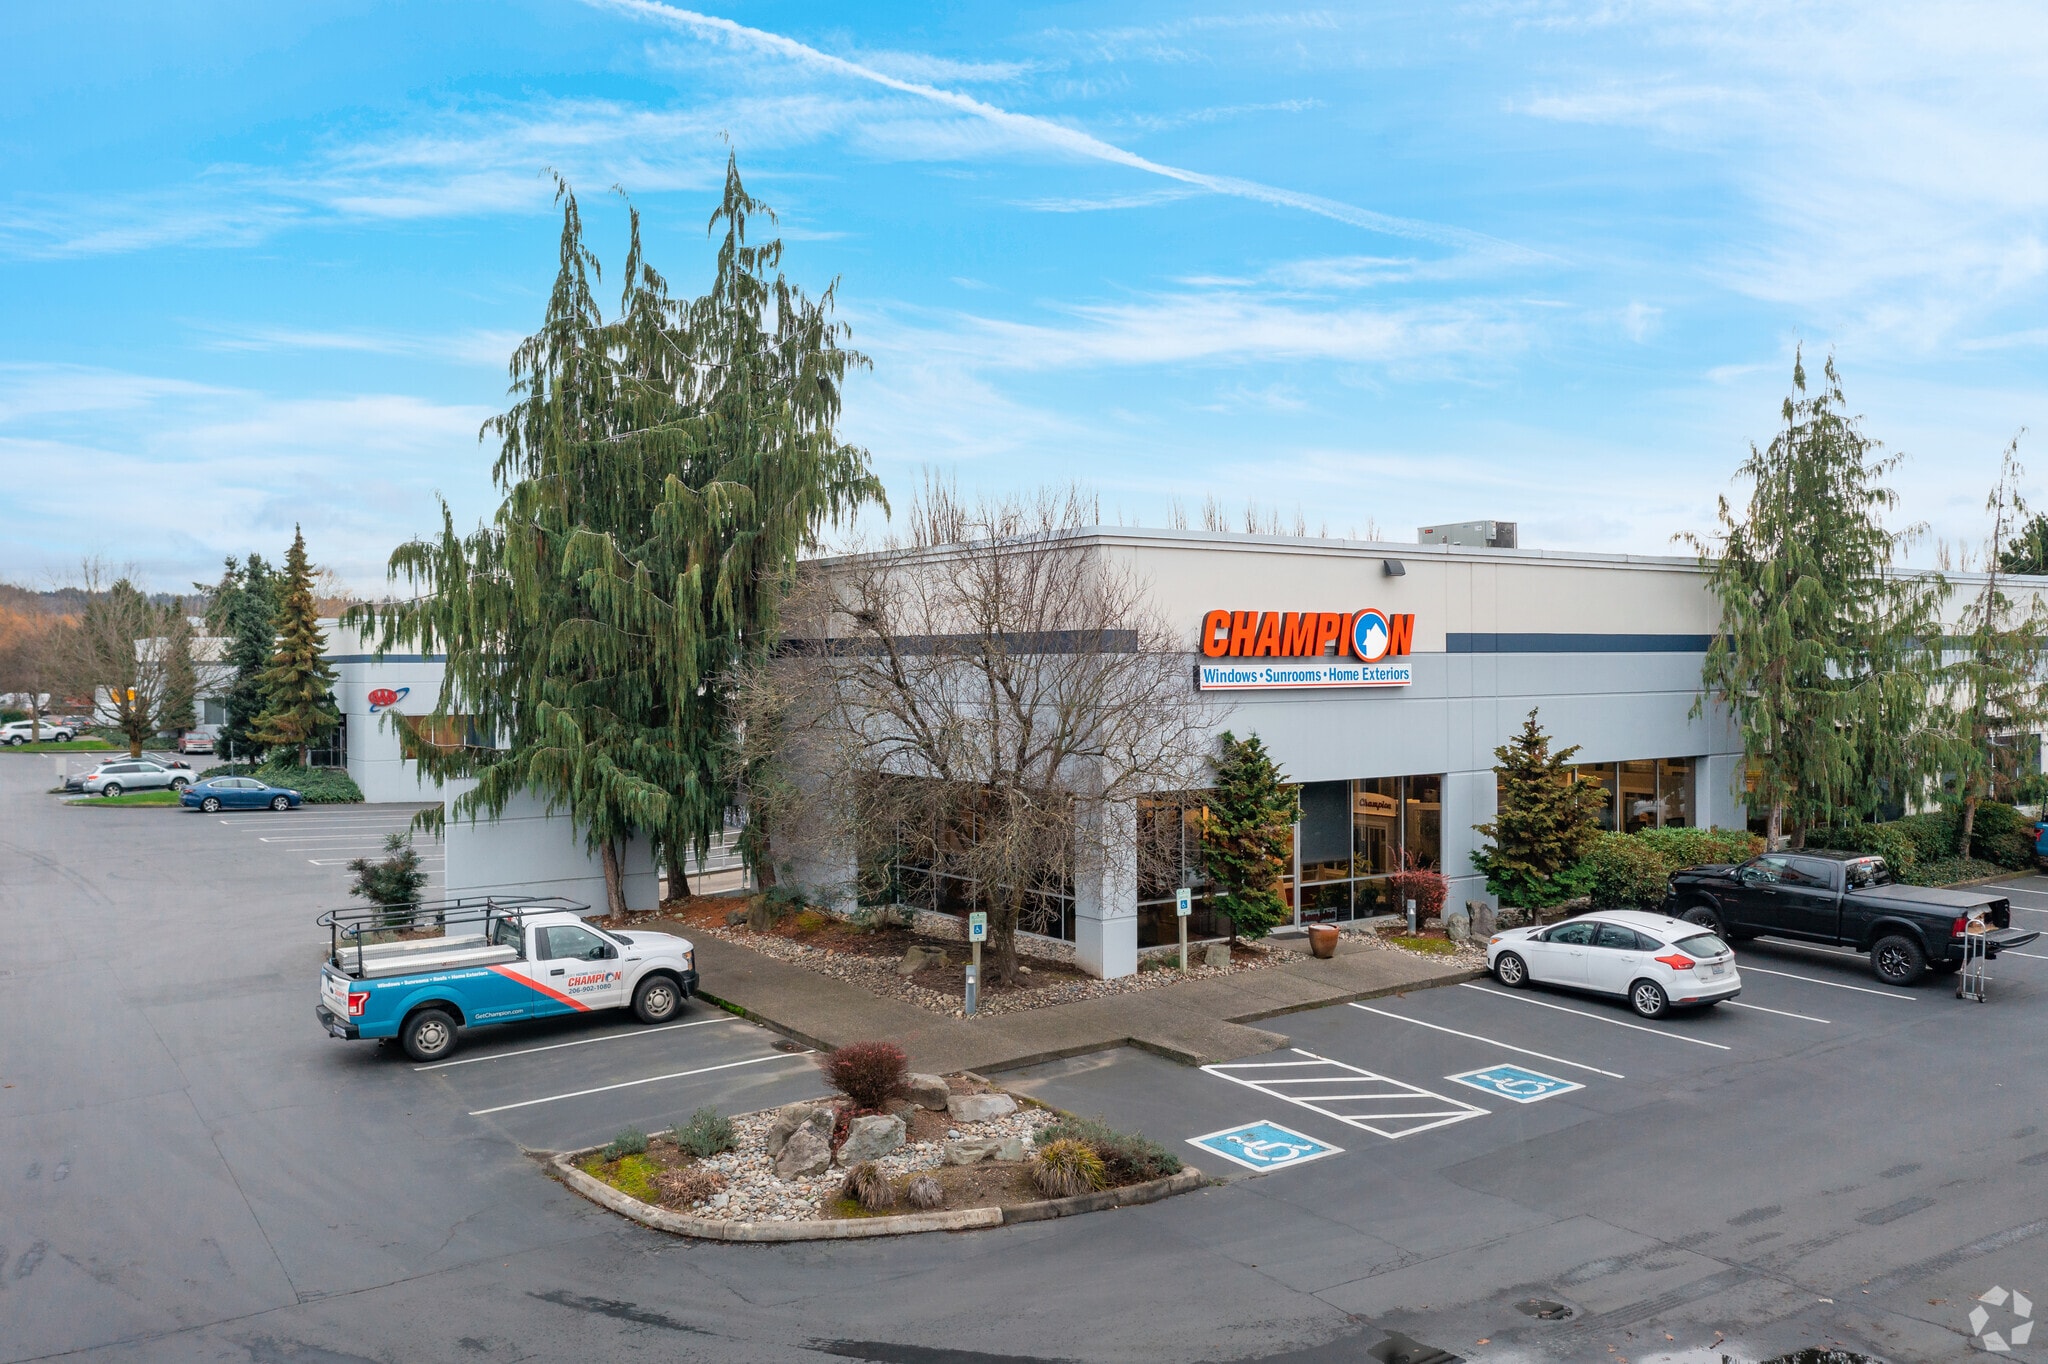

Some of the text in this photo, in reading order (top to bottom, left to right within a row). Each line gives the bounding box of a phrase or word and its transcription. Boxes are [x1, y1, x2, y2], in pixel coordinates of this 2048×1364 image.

[1202, 608, 1415, 663] CHAMPION
[1203, 666, 1410, 683] Windows Sunrooms Home Exteriors
[1359, 798, 1392, 811] Champion
[568, 971, 622, 987] CHAMPION
[568, 983, 612, 994] 206-902-1080
[474, 1009, 524, 1020] GetChampion.com
